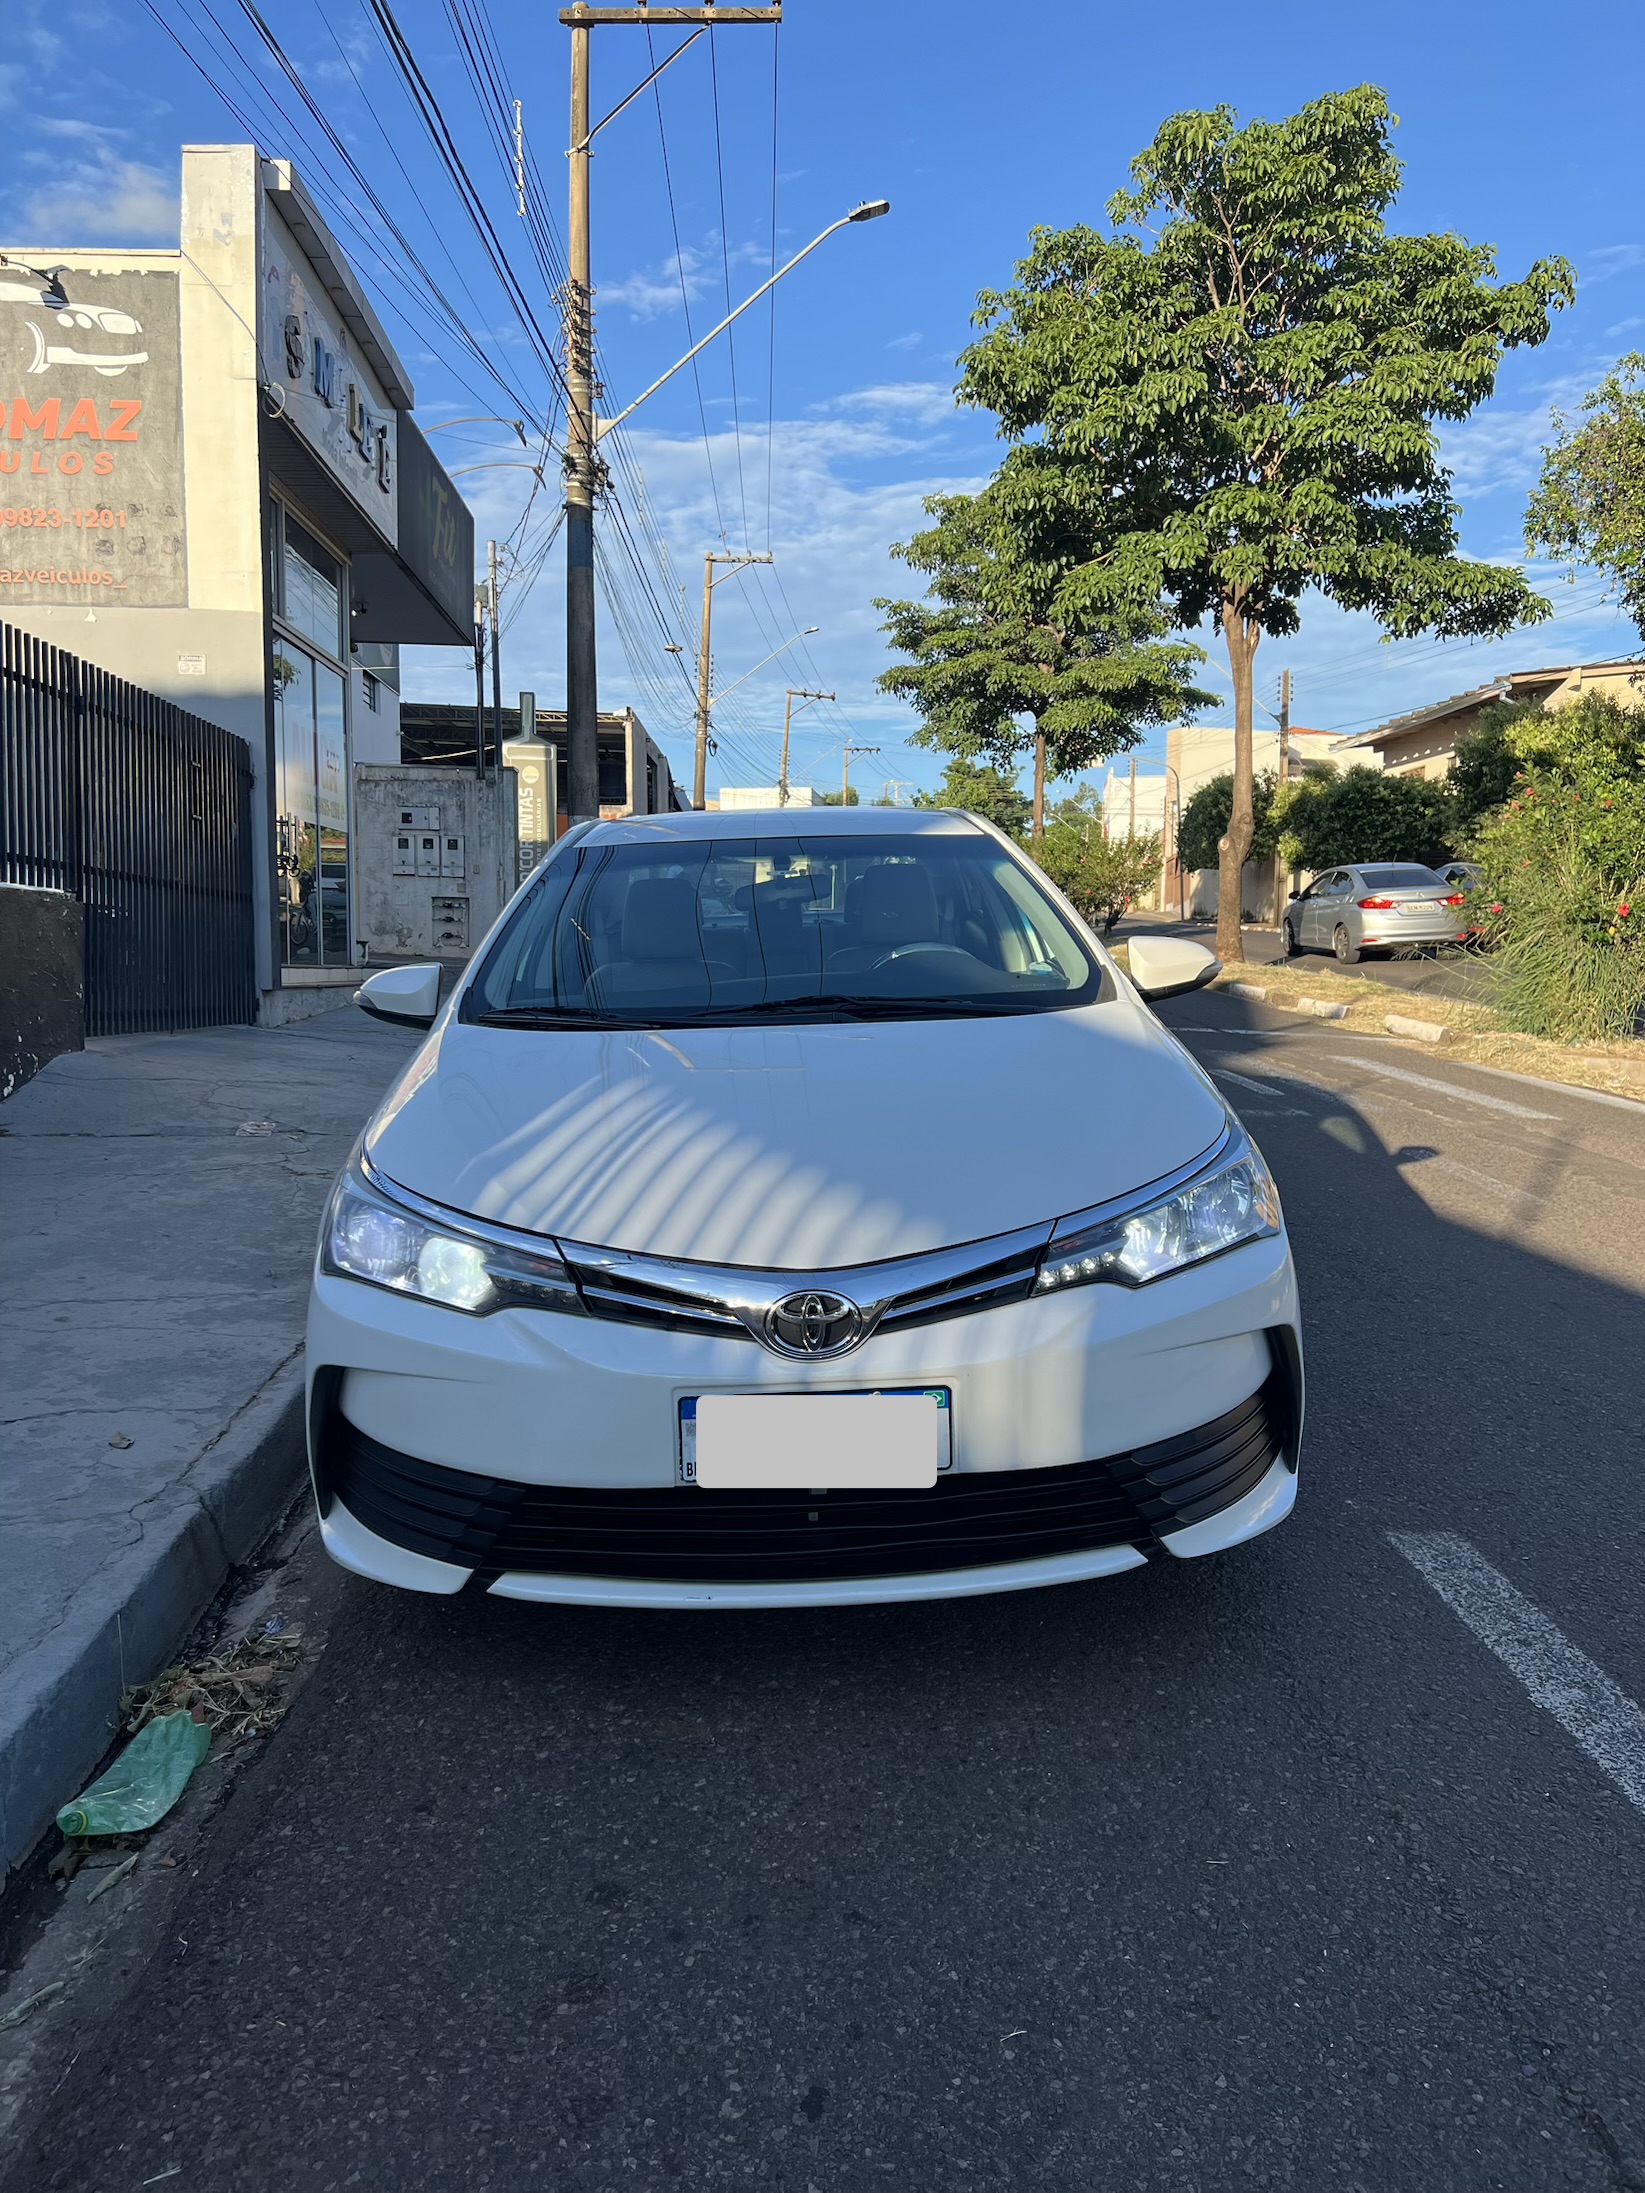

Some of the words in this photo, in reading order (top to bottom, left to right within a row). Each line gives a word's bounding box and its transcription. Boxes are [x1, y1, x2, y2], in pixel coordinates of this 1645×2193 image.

[0, 396, 143, 442] MAZ
[0, 507, 127, 529] 9823-1201
[519, 787, 534, 837] TINTAS
